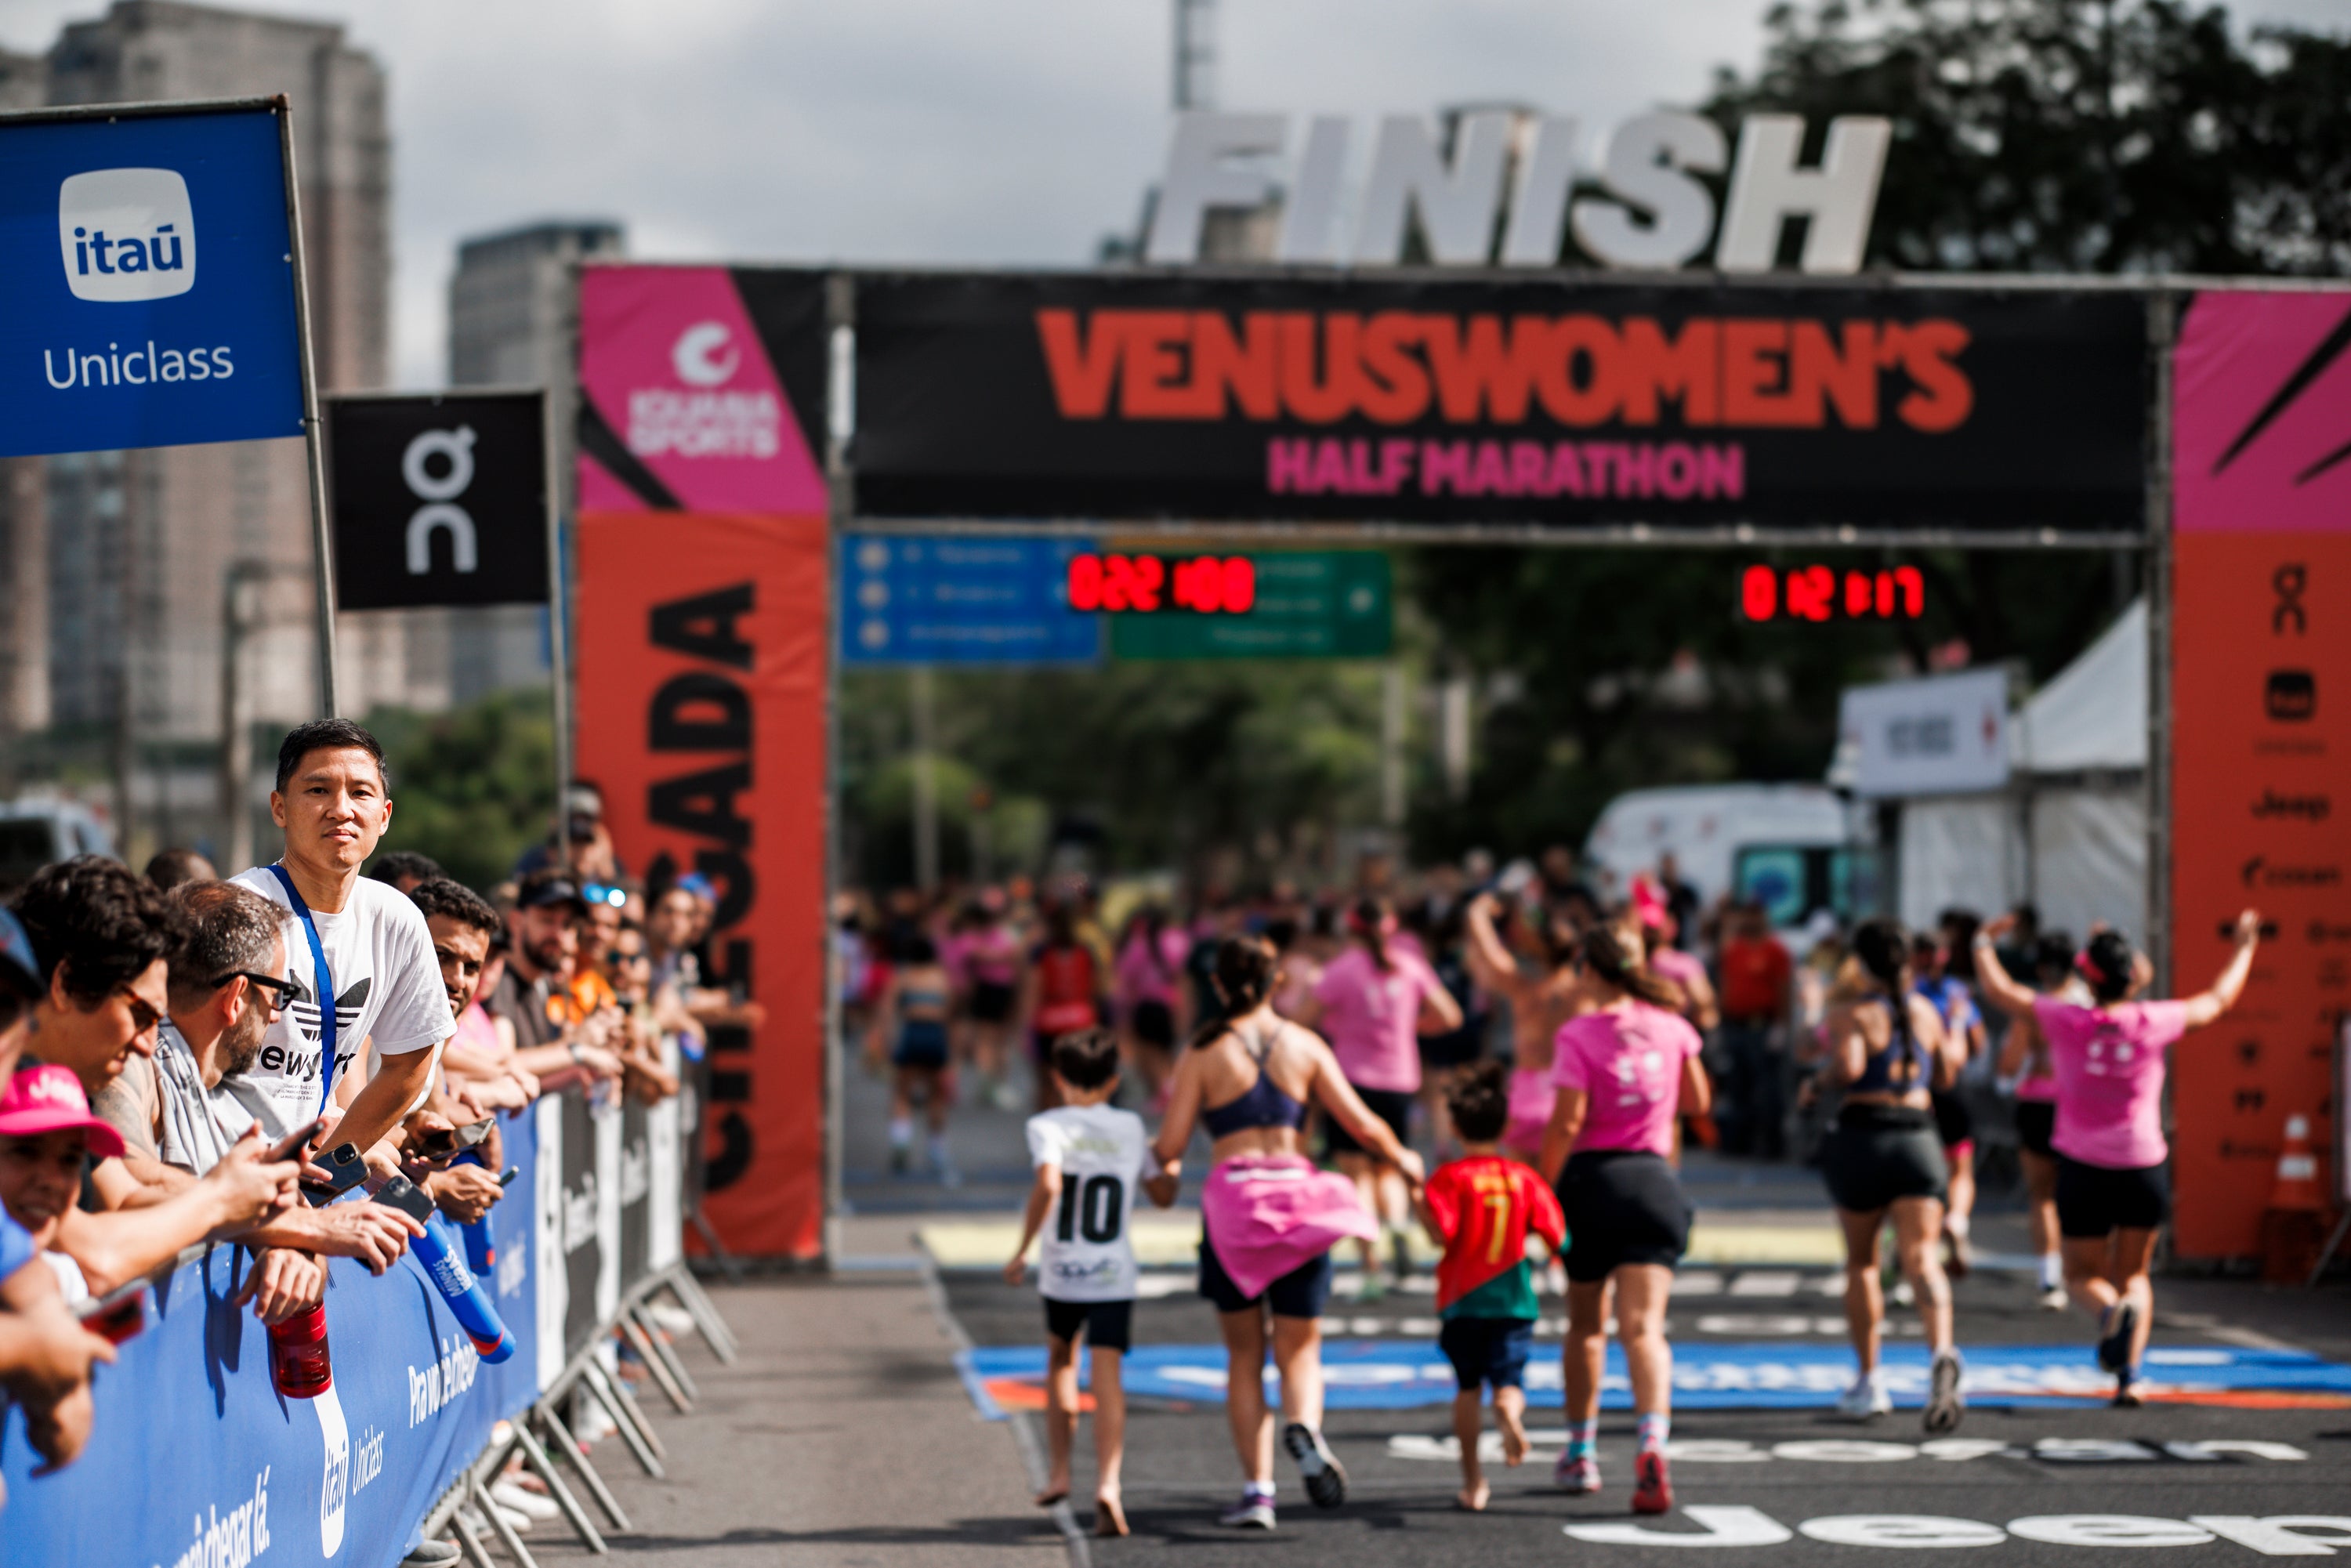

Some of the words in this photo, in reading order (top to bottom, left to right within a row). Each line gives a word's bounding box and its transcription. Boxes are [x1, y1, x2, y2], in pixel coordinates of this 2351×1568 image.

[1146, 111, 1891, 275] FINISH
[74, 223, 183, 276] itaú
[44, 341, 234, 390] Uniclass
[1267, 437, 1414, 495] HALF
[1421, 440, 1745, 500] MARATHON
[1057, 1174, 1123, 1244] 10
[1483, 1194, 1511, 1265] 7
[408, 1364, 427, 1429] Pra
[353, 1424, 384, 1497] Uniclass
[1563, 1505, 2351, 1555] Jeep
